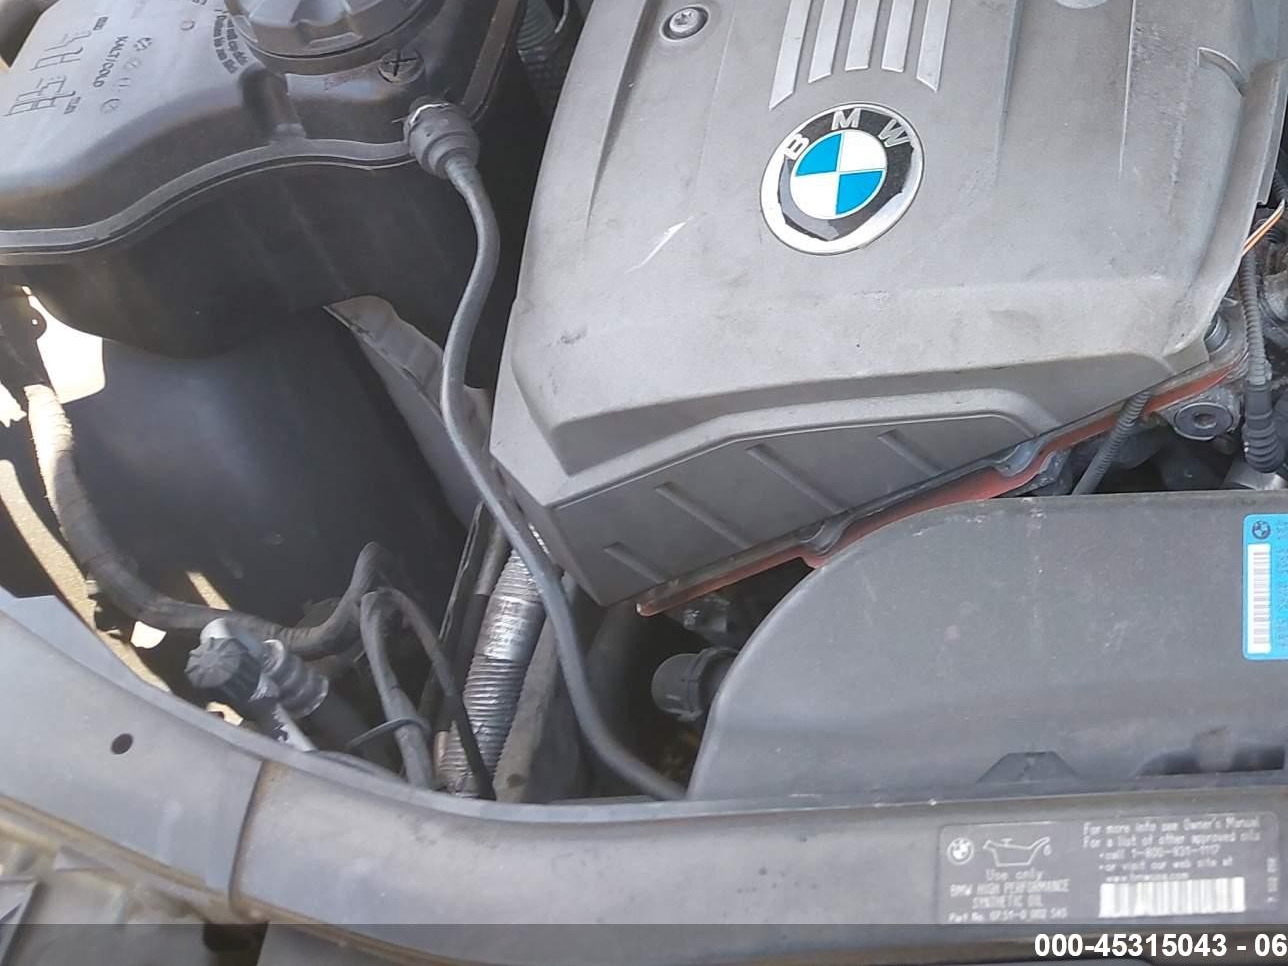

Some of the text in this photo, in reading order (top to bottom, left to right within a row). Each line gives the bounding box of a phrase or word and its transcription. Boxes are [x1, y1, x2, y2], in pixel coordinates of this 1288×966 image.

[93, 35, 129, 88] KALT/COLD
[784, 108, 913, 160] BMW
[1083, 821, 1101, 836] For
[1083, 835, 1101, 848] For
[1191, 831, 1236, 846] approved
[1003, 878, 1070, 894] PERFORMANCE
